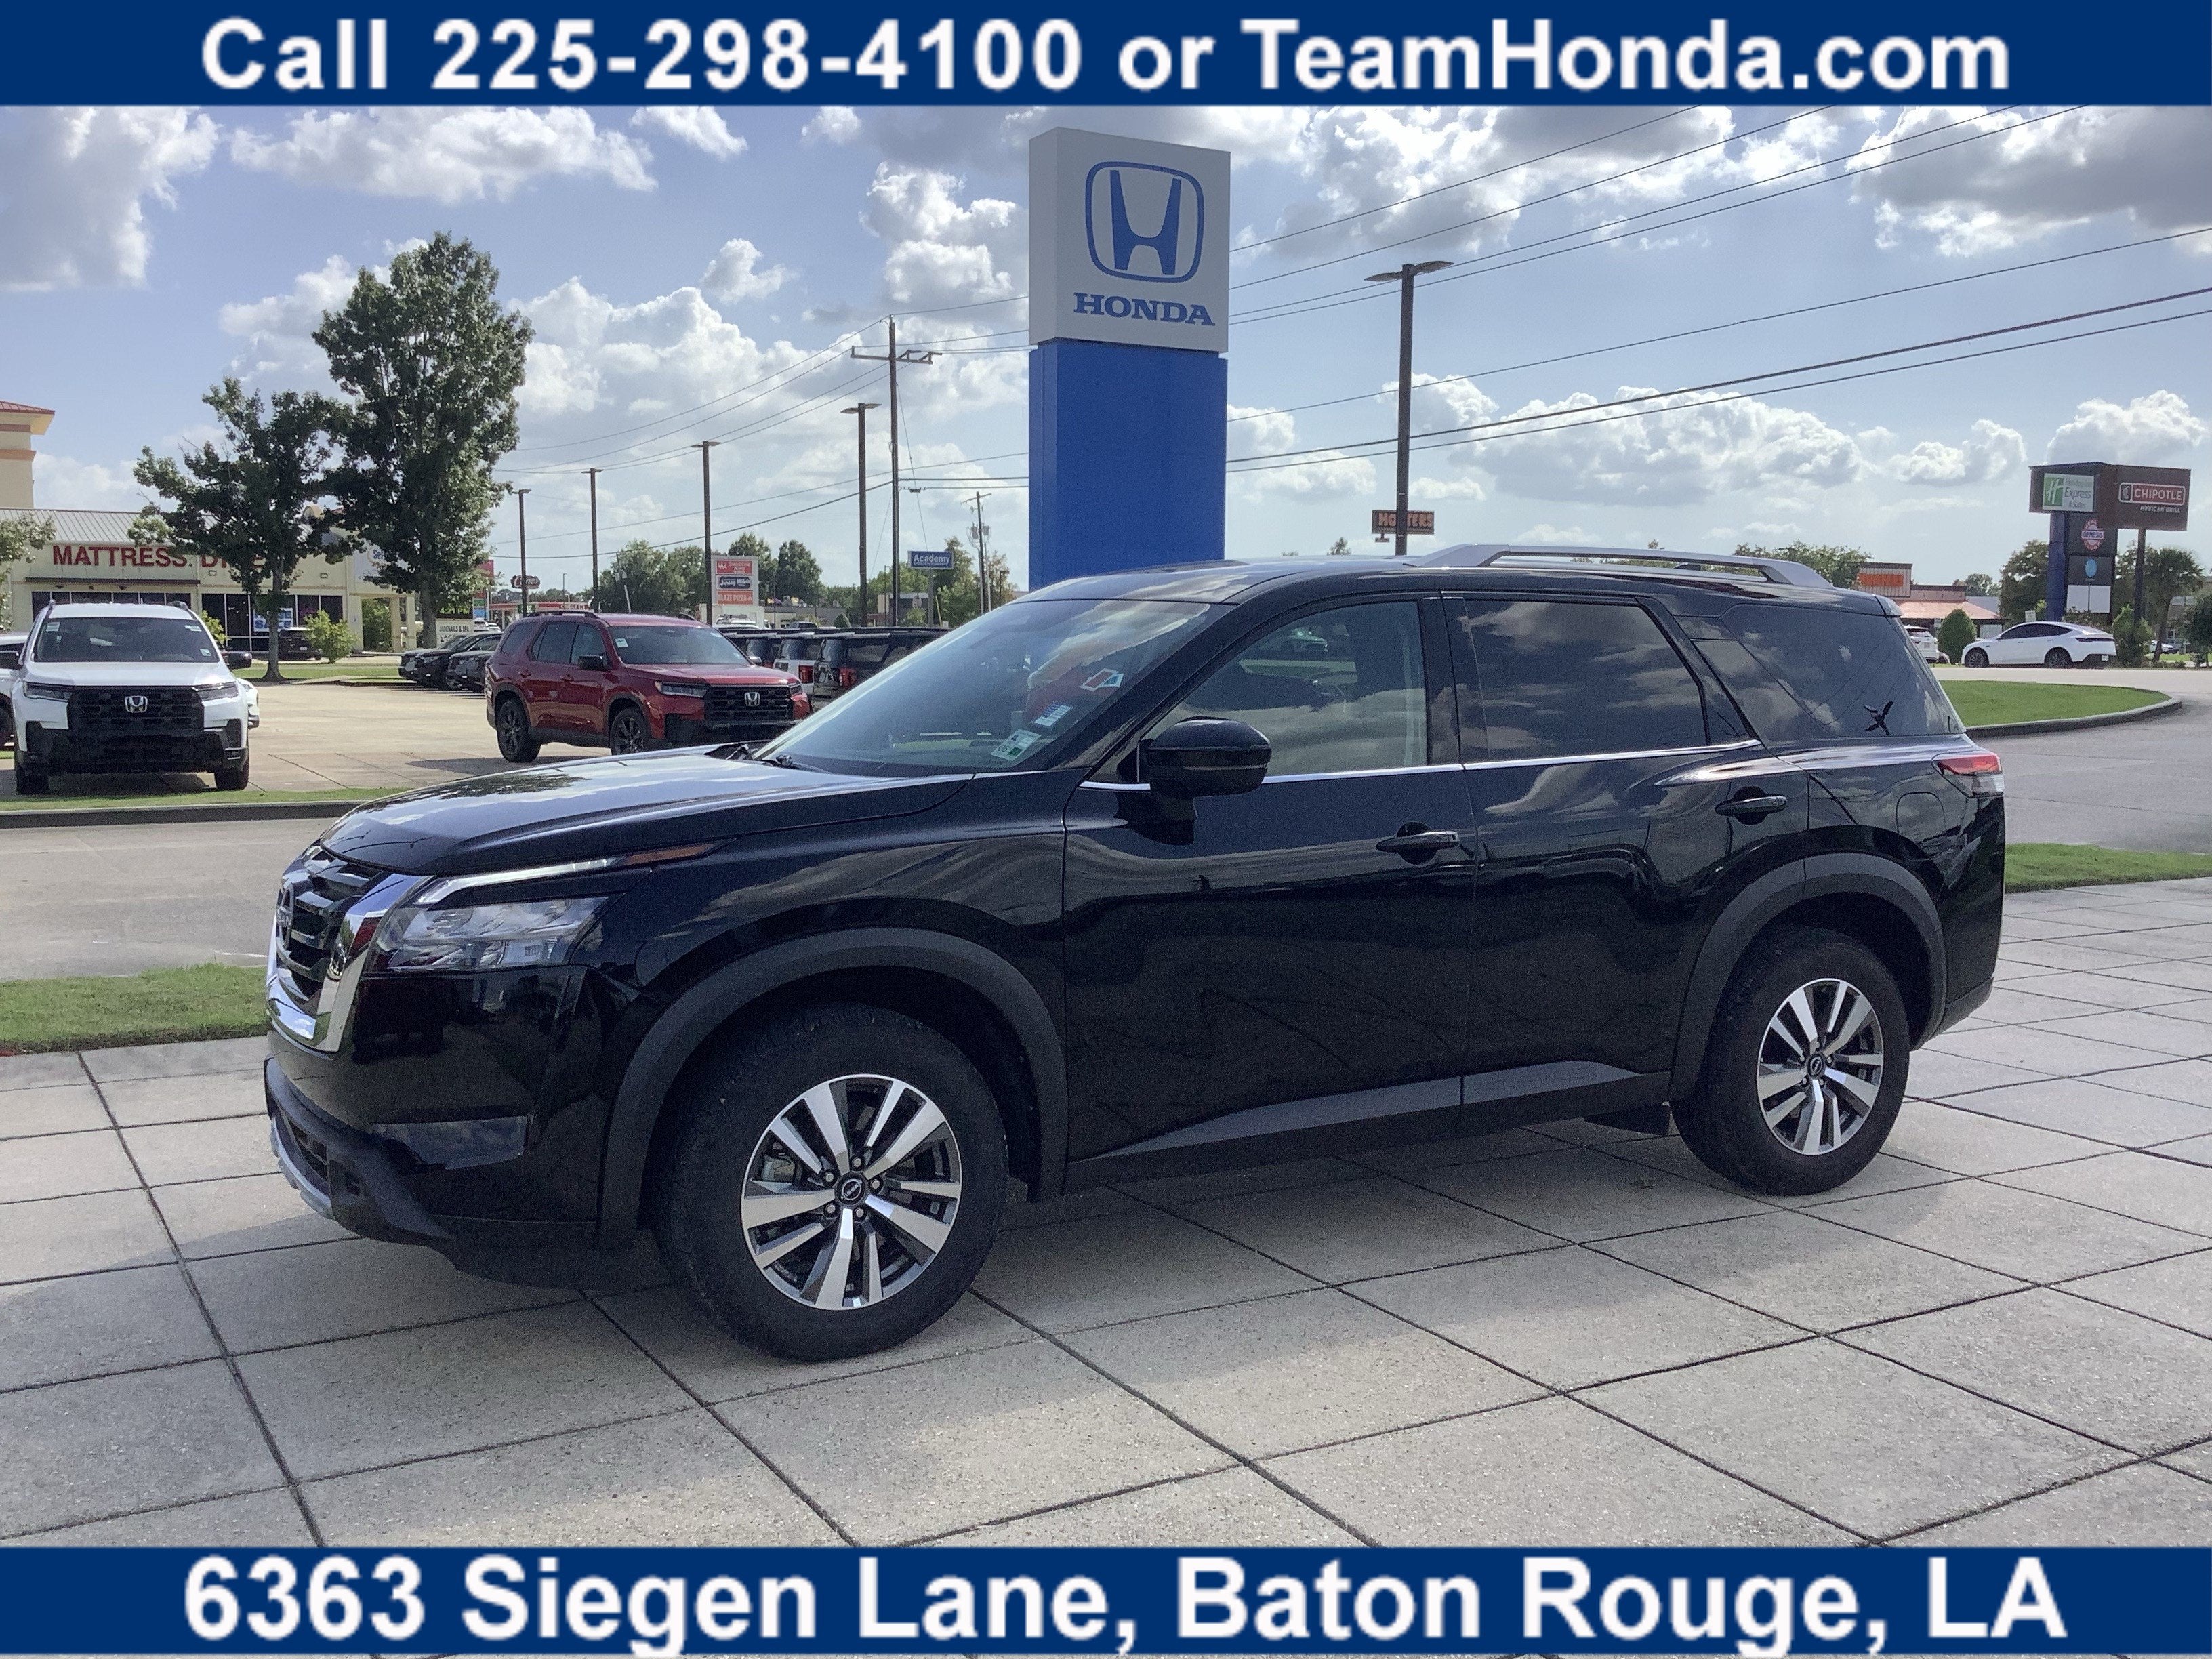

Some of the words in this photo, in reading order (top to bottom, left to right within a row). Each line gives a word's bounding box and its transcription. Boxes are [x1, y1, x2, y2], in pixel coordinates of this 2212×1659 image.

[1073, 292, 1215, 326] HONDA
[2064, 487, 2091, 499] Express
[2134, 488, 2182, 501] CHIPOTLE
[1378, 512, 1434, 527] HOTERS
[53, 545, 188, 568] MATTRESS
[914, 554, 950, 565] Academy
